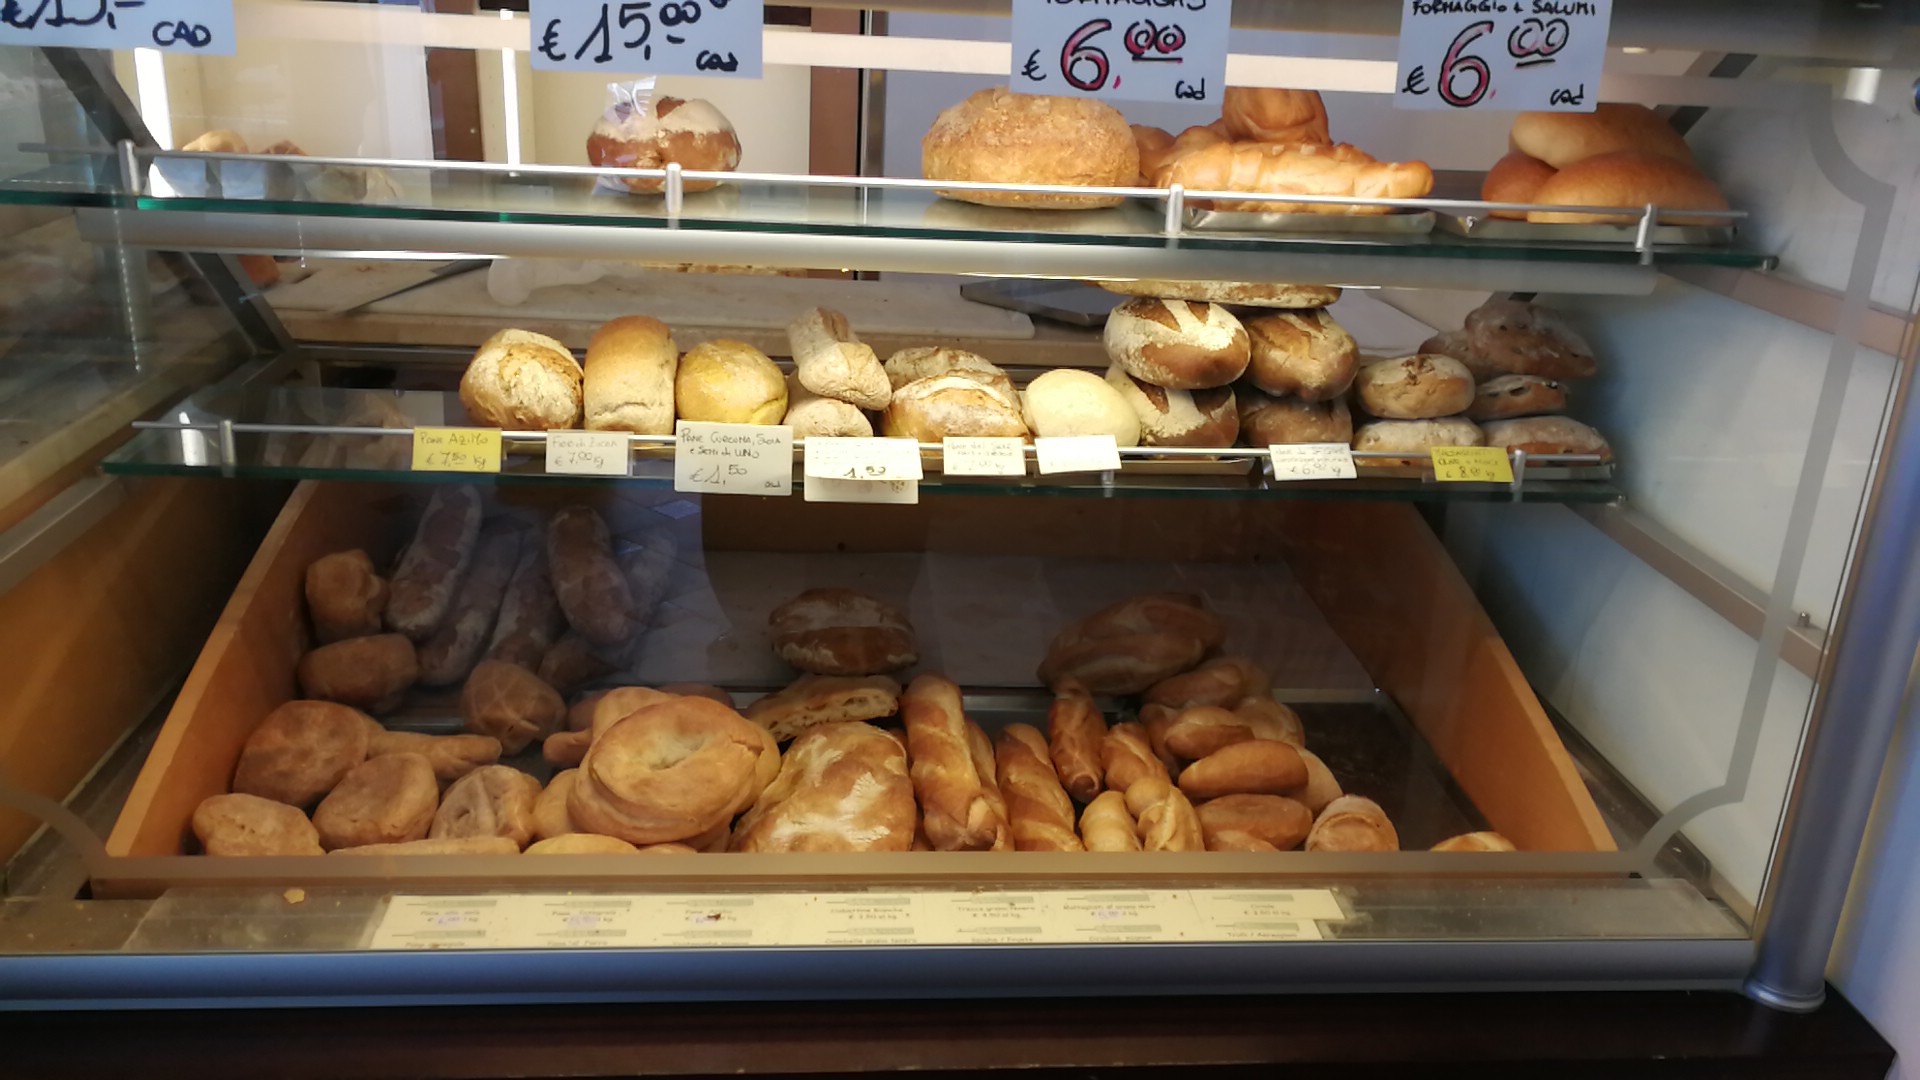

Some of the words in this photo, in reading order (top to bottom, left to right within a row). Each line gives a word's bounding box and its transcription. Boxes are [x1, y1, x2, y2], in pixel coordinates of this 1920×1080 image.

[1531, 0, 1596, 16] SALUMI
[537, 18, 566, 62] €
[1020, 48, 1048, 82] €
[1401, 65, 1430, 95] €
